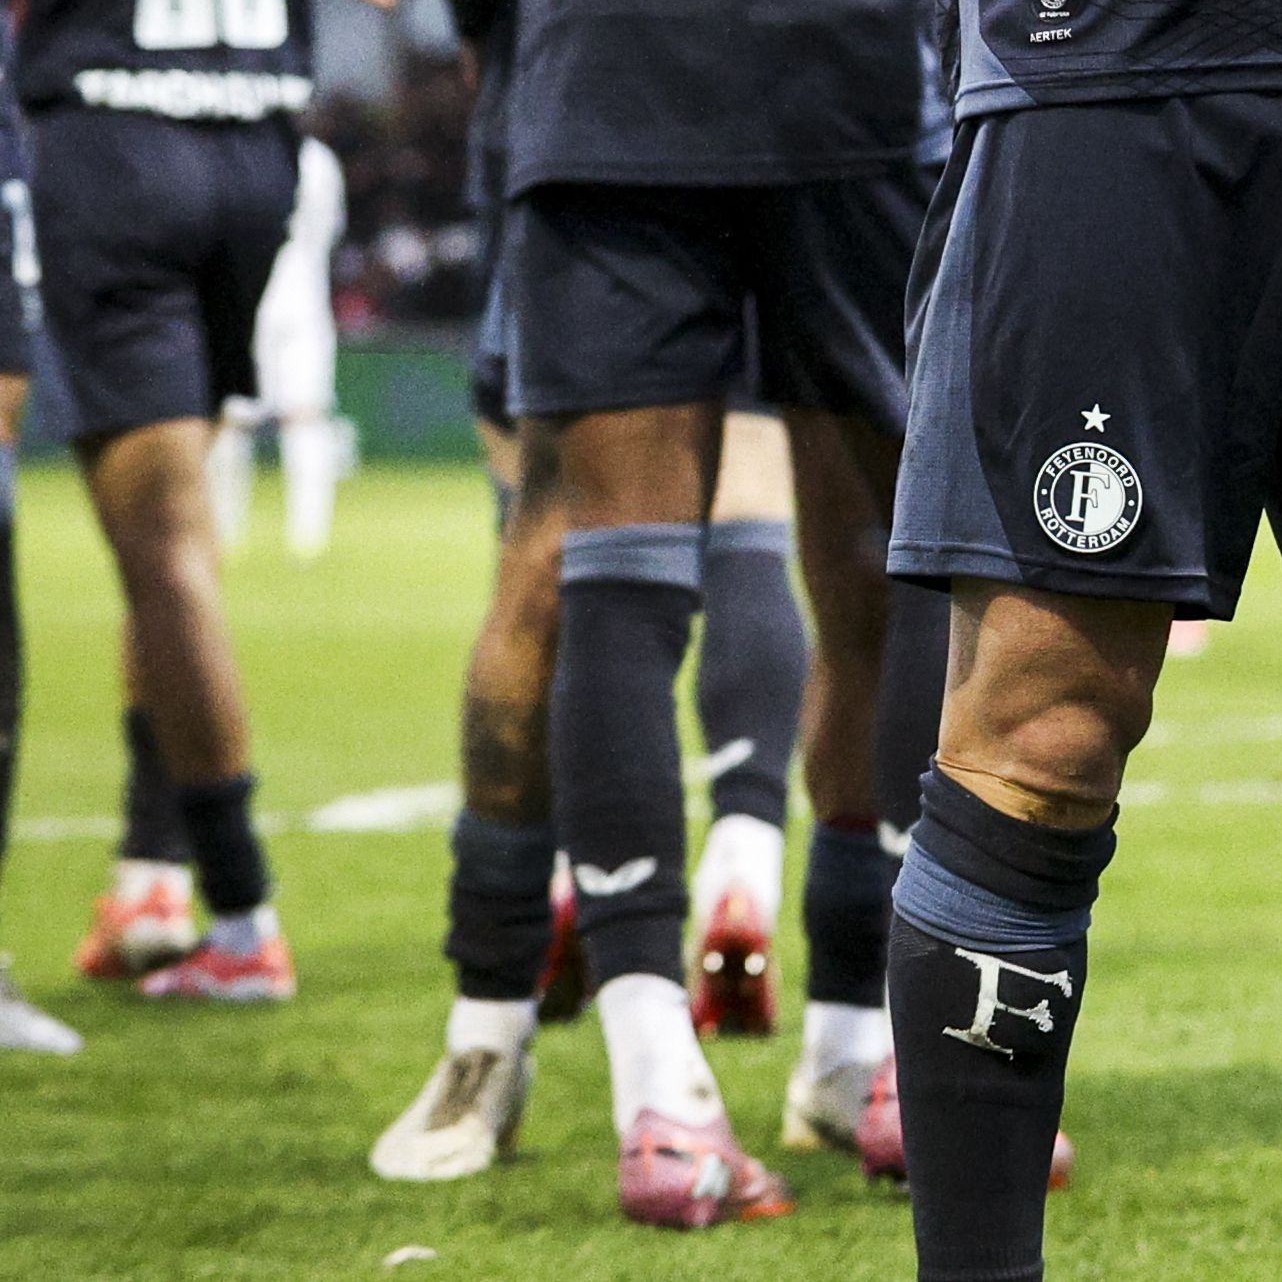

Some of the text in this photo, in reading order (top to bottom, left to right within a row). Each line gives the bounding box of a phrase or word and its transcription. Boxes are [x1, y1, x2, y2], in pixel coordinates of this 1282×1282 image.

[1030, 28, 1072, 43] AERTEK
[1045, 447, 1135, 488] FEYENOORD
[1040, 507, 1131, 548] ROTTERDAM
[942, 947, 1073, 1061] F
